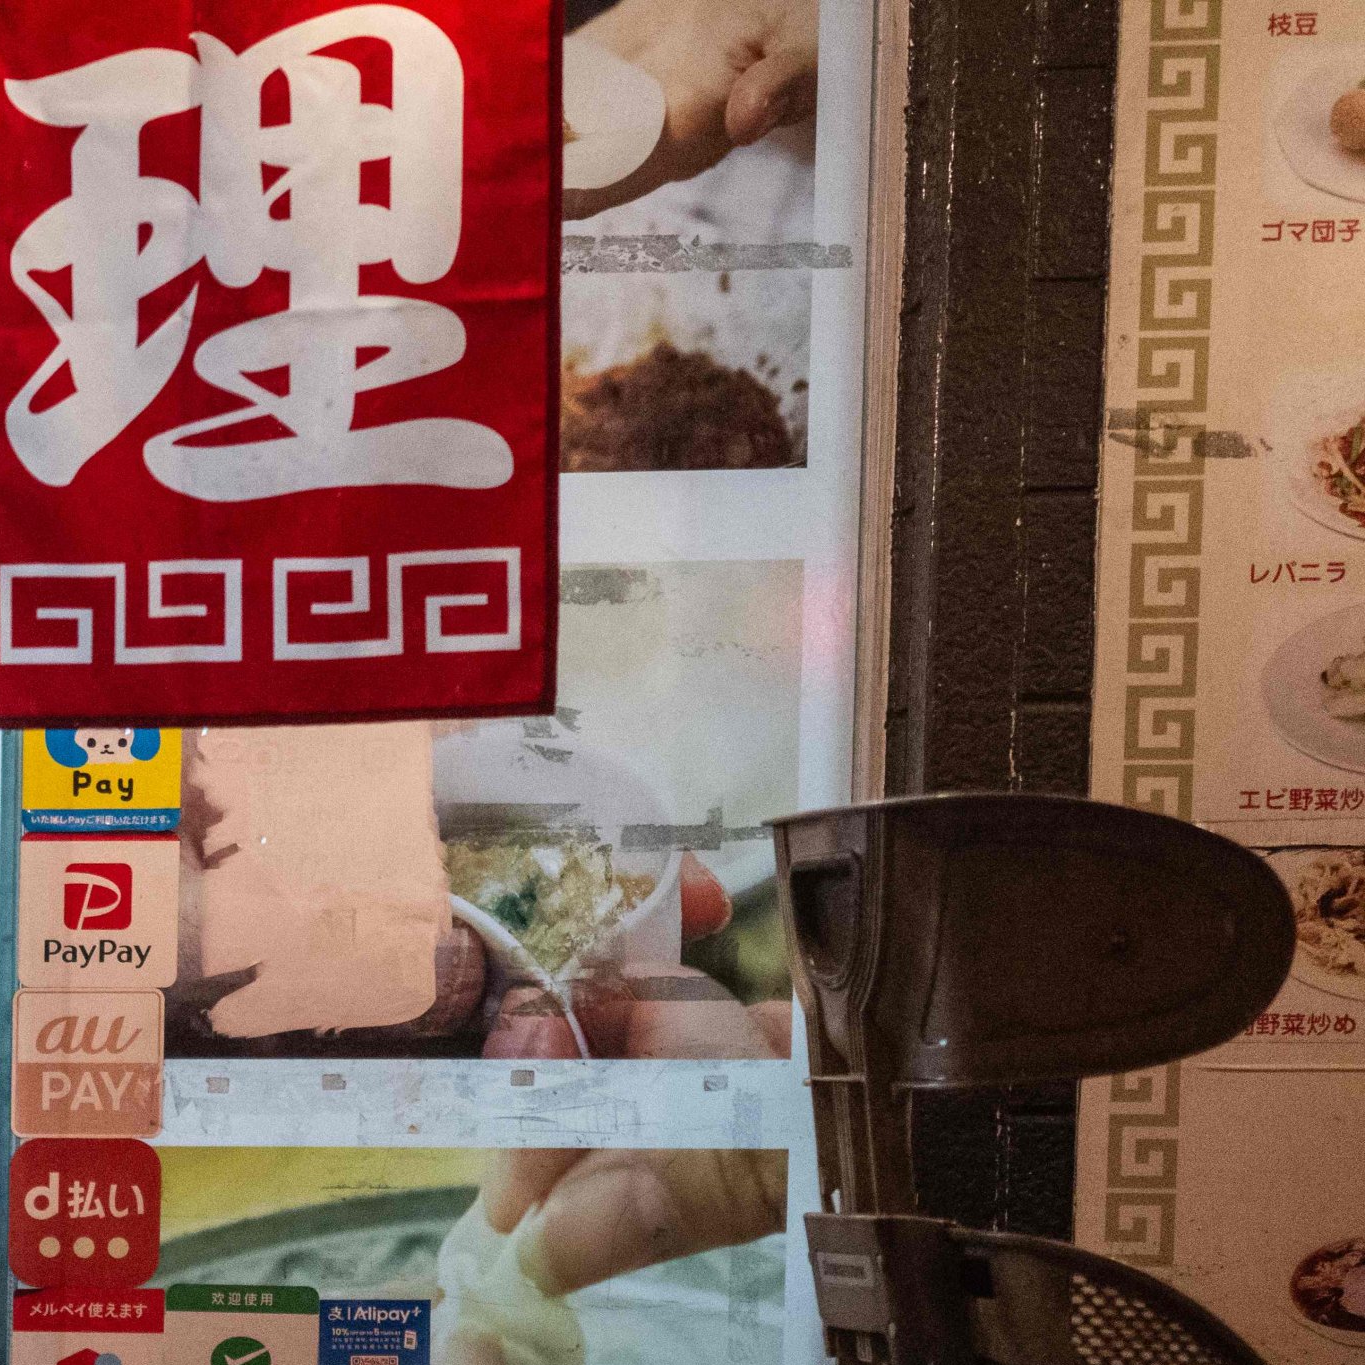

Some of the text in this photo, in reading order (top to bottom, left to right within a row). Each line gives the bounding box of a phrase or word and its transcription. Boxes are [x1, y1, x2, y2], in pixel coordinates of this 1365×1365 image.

[1268, 12, 1319, 38] 枝豆
[1261, 219, 1362, 244] ゴマ団子
[1249, 561, 1348, 585] レバニラ
[72, 770, 134, 801] Pay
[43, 939, 152, 969] PayPay
[35, 1015, 143, 1055] au
[41, 1070, 135, 1111] PAY
[23, 1171, 146, 1221] d払い
[29, 1301, 148, 1319] メルペイ使えます
[211, 1291, 275, 1307] 欢迎使用
